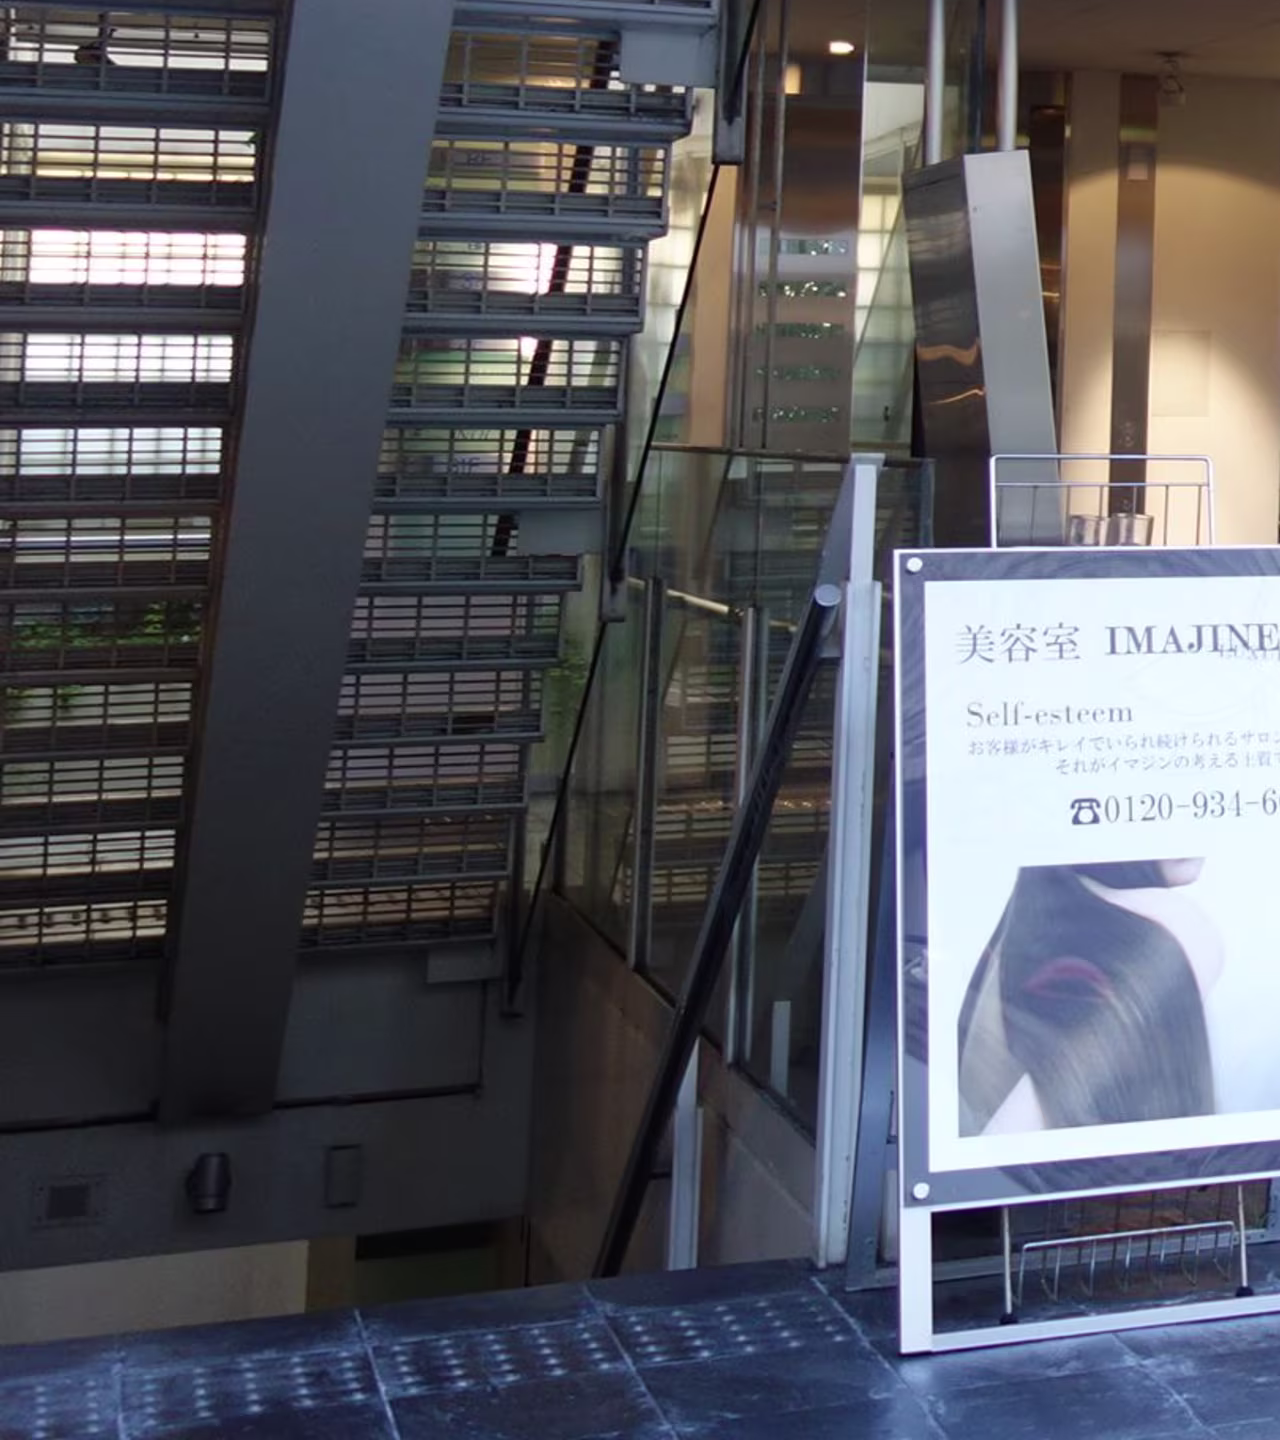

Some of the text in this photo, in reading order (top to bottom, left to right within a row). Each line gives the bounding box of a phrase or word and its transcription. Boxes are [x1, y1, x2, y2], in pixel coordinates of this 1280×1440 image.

[955, 622, 1082, 665] 美容室
[965, 701, 1134, 729] Self-esteem
